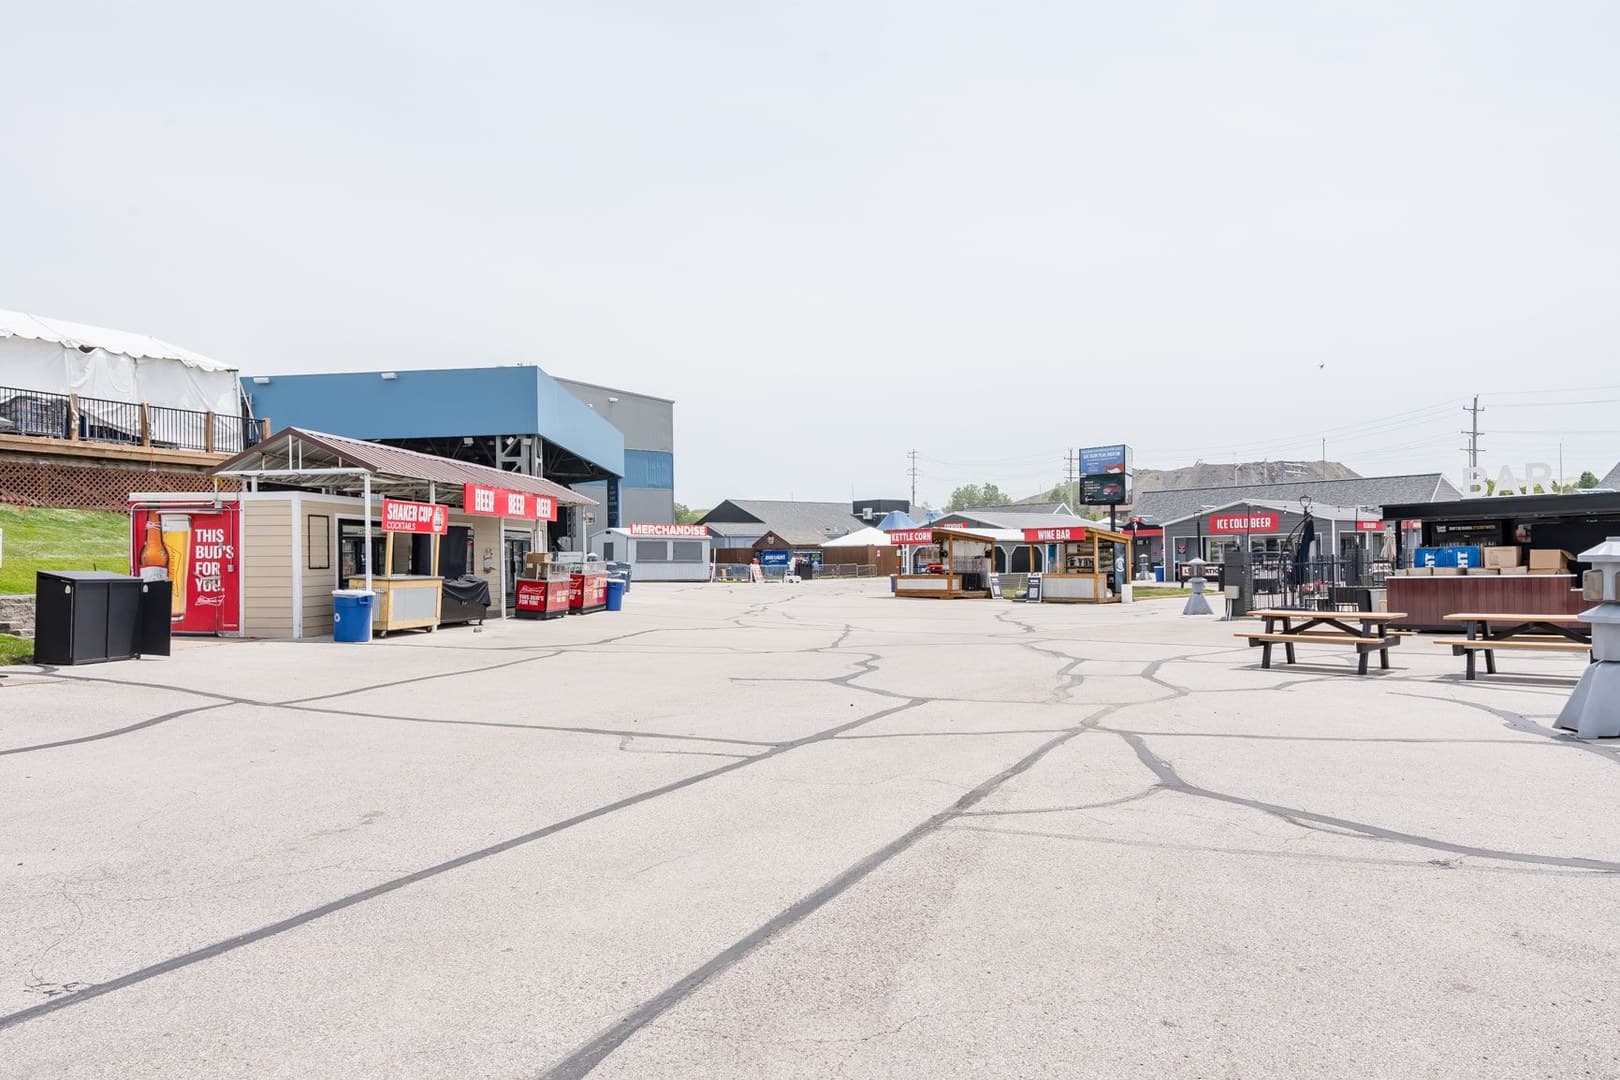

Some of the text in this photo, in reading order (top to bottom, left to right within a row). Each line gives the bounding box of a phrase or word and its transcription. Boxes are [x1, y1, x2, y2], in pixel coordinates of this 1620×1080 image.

[1463, 462, 1553, 498] BAR
[475, 488, 551, 519] BEER BEER BEER
[387, 503, 433, 523] SHAKER CUP
[386, 521, 416, 530] COCKTAILS
[631, 524, 706, 536] MERCHANDISE
[1216, 517, 1271, 529] ICE COLD BEER
[195, 529, 224, 543] THIS
[891, 531, 931, 541] KETTLE CORN
[1037, 529, 1071, 540] WINE BAR
[195, 545, 234, 559] BUD'S
[195, 561, 220, 576] FOR
